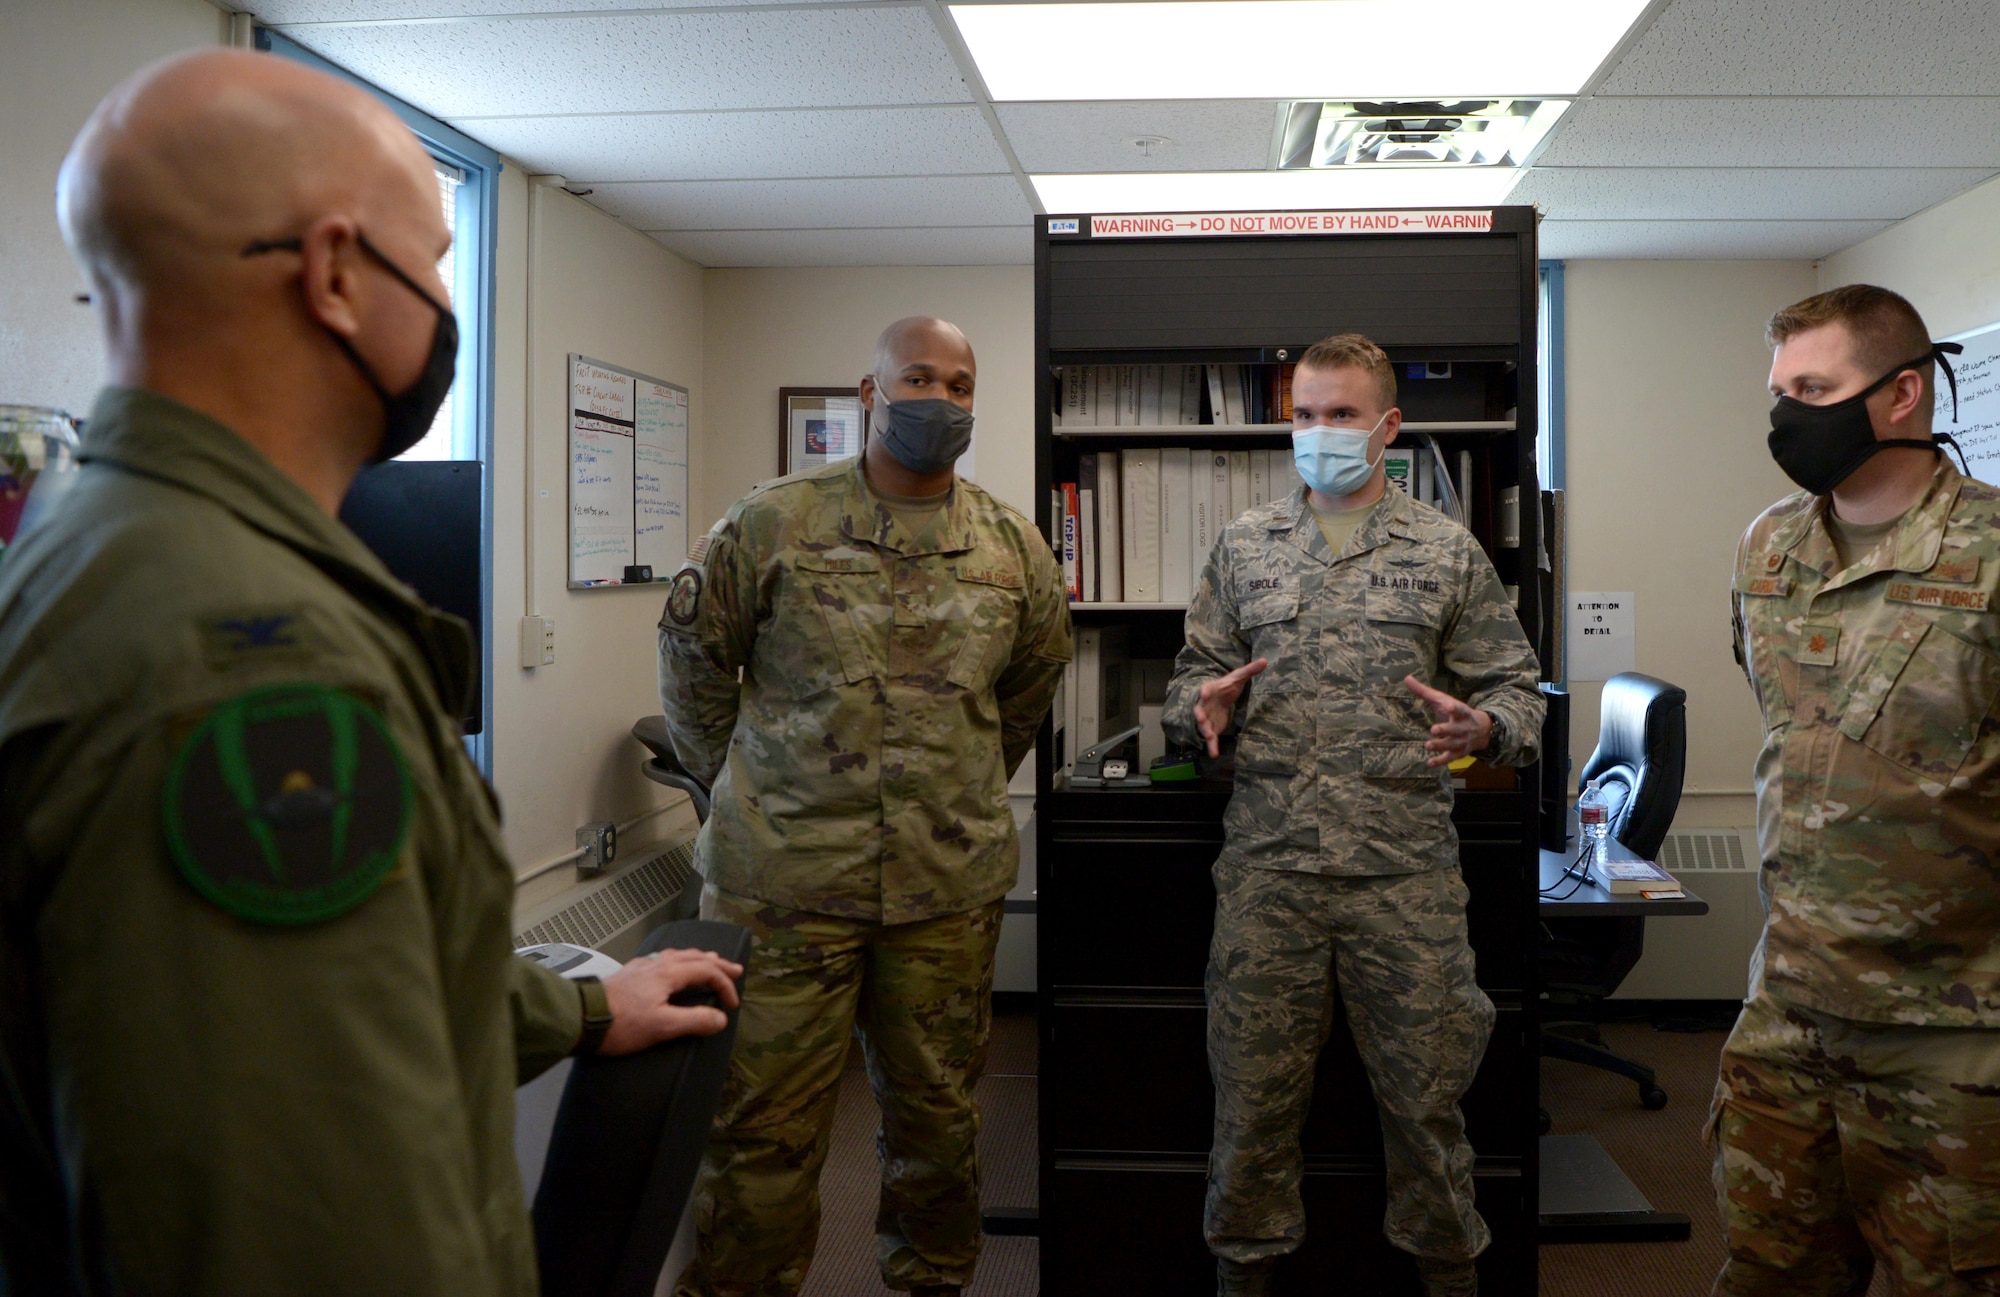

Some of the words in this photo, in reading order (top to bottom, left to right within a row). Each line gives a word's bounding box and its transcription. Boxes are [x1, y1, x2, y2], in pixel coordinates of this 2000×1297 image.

[1094, 218, 1174, 233] WARNING
[1200, 218, 1225, 231] DO
[1230, 217, 1264, 231] NOT
[1270, 216, 1318, 230] MOVE
[1323, 216, 1346, 229] BY
[1350, 215, 1399, 229] HAND
[1080, 366, 1089, 415] anagement
[1065, 517, 1074, 561] TCP/IP
[824, 559, 852, 571] MILES
[980, 571, 993, 581] AIR
[995, 573, 1018, 586] FORCE
[1249, 577, 1279, 591] SIBOLE
[1371, 575, 1388, 587] U.S.
[1392, 578, 1409, 589] AIR
[1412, 579, 1440, 593] FORCE
[1915, 586, 1938, 603] AIR
[1941, 588, 1985, 608] FORCE
